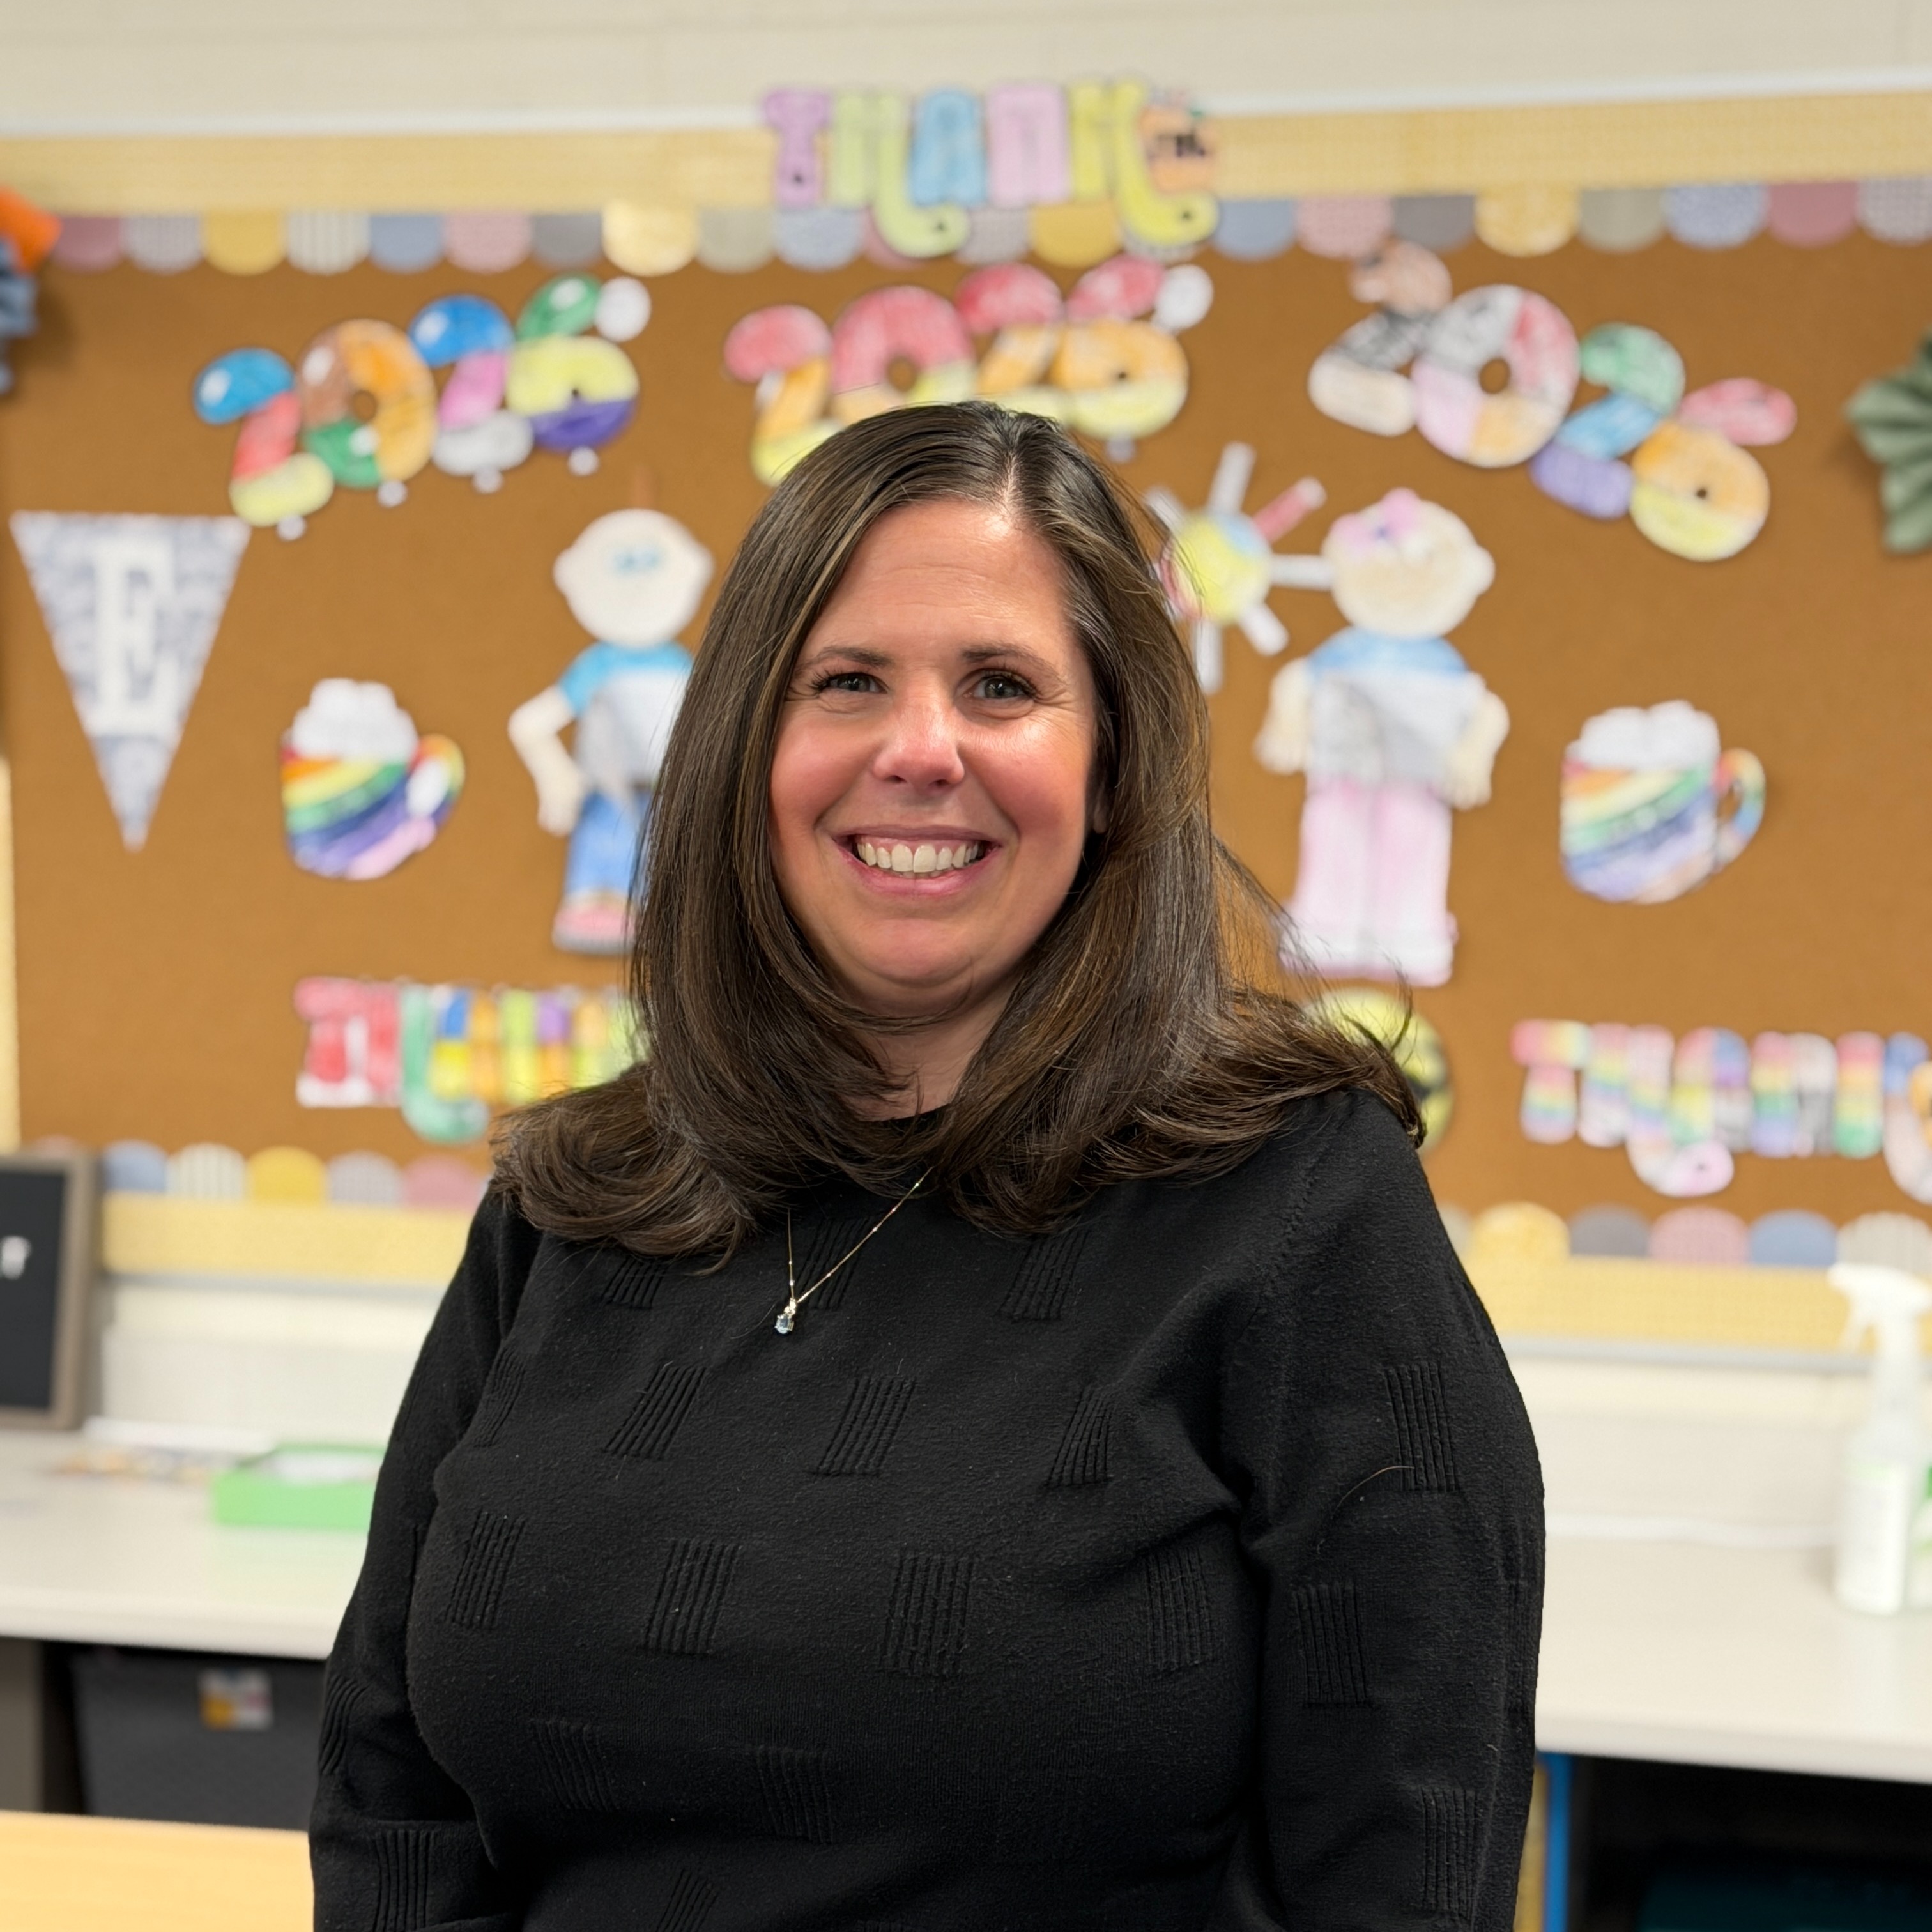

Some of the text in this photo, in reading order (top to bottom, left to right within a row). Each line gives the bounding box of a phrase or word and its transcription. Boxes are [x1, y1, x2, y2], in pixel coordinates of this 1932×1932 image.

[194, 273, 652, 528] 2026
[723, 257, 1214, 488] 2026
[1307, 241, 1798, 562] 2026
[86, 538, 180, 739] E
